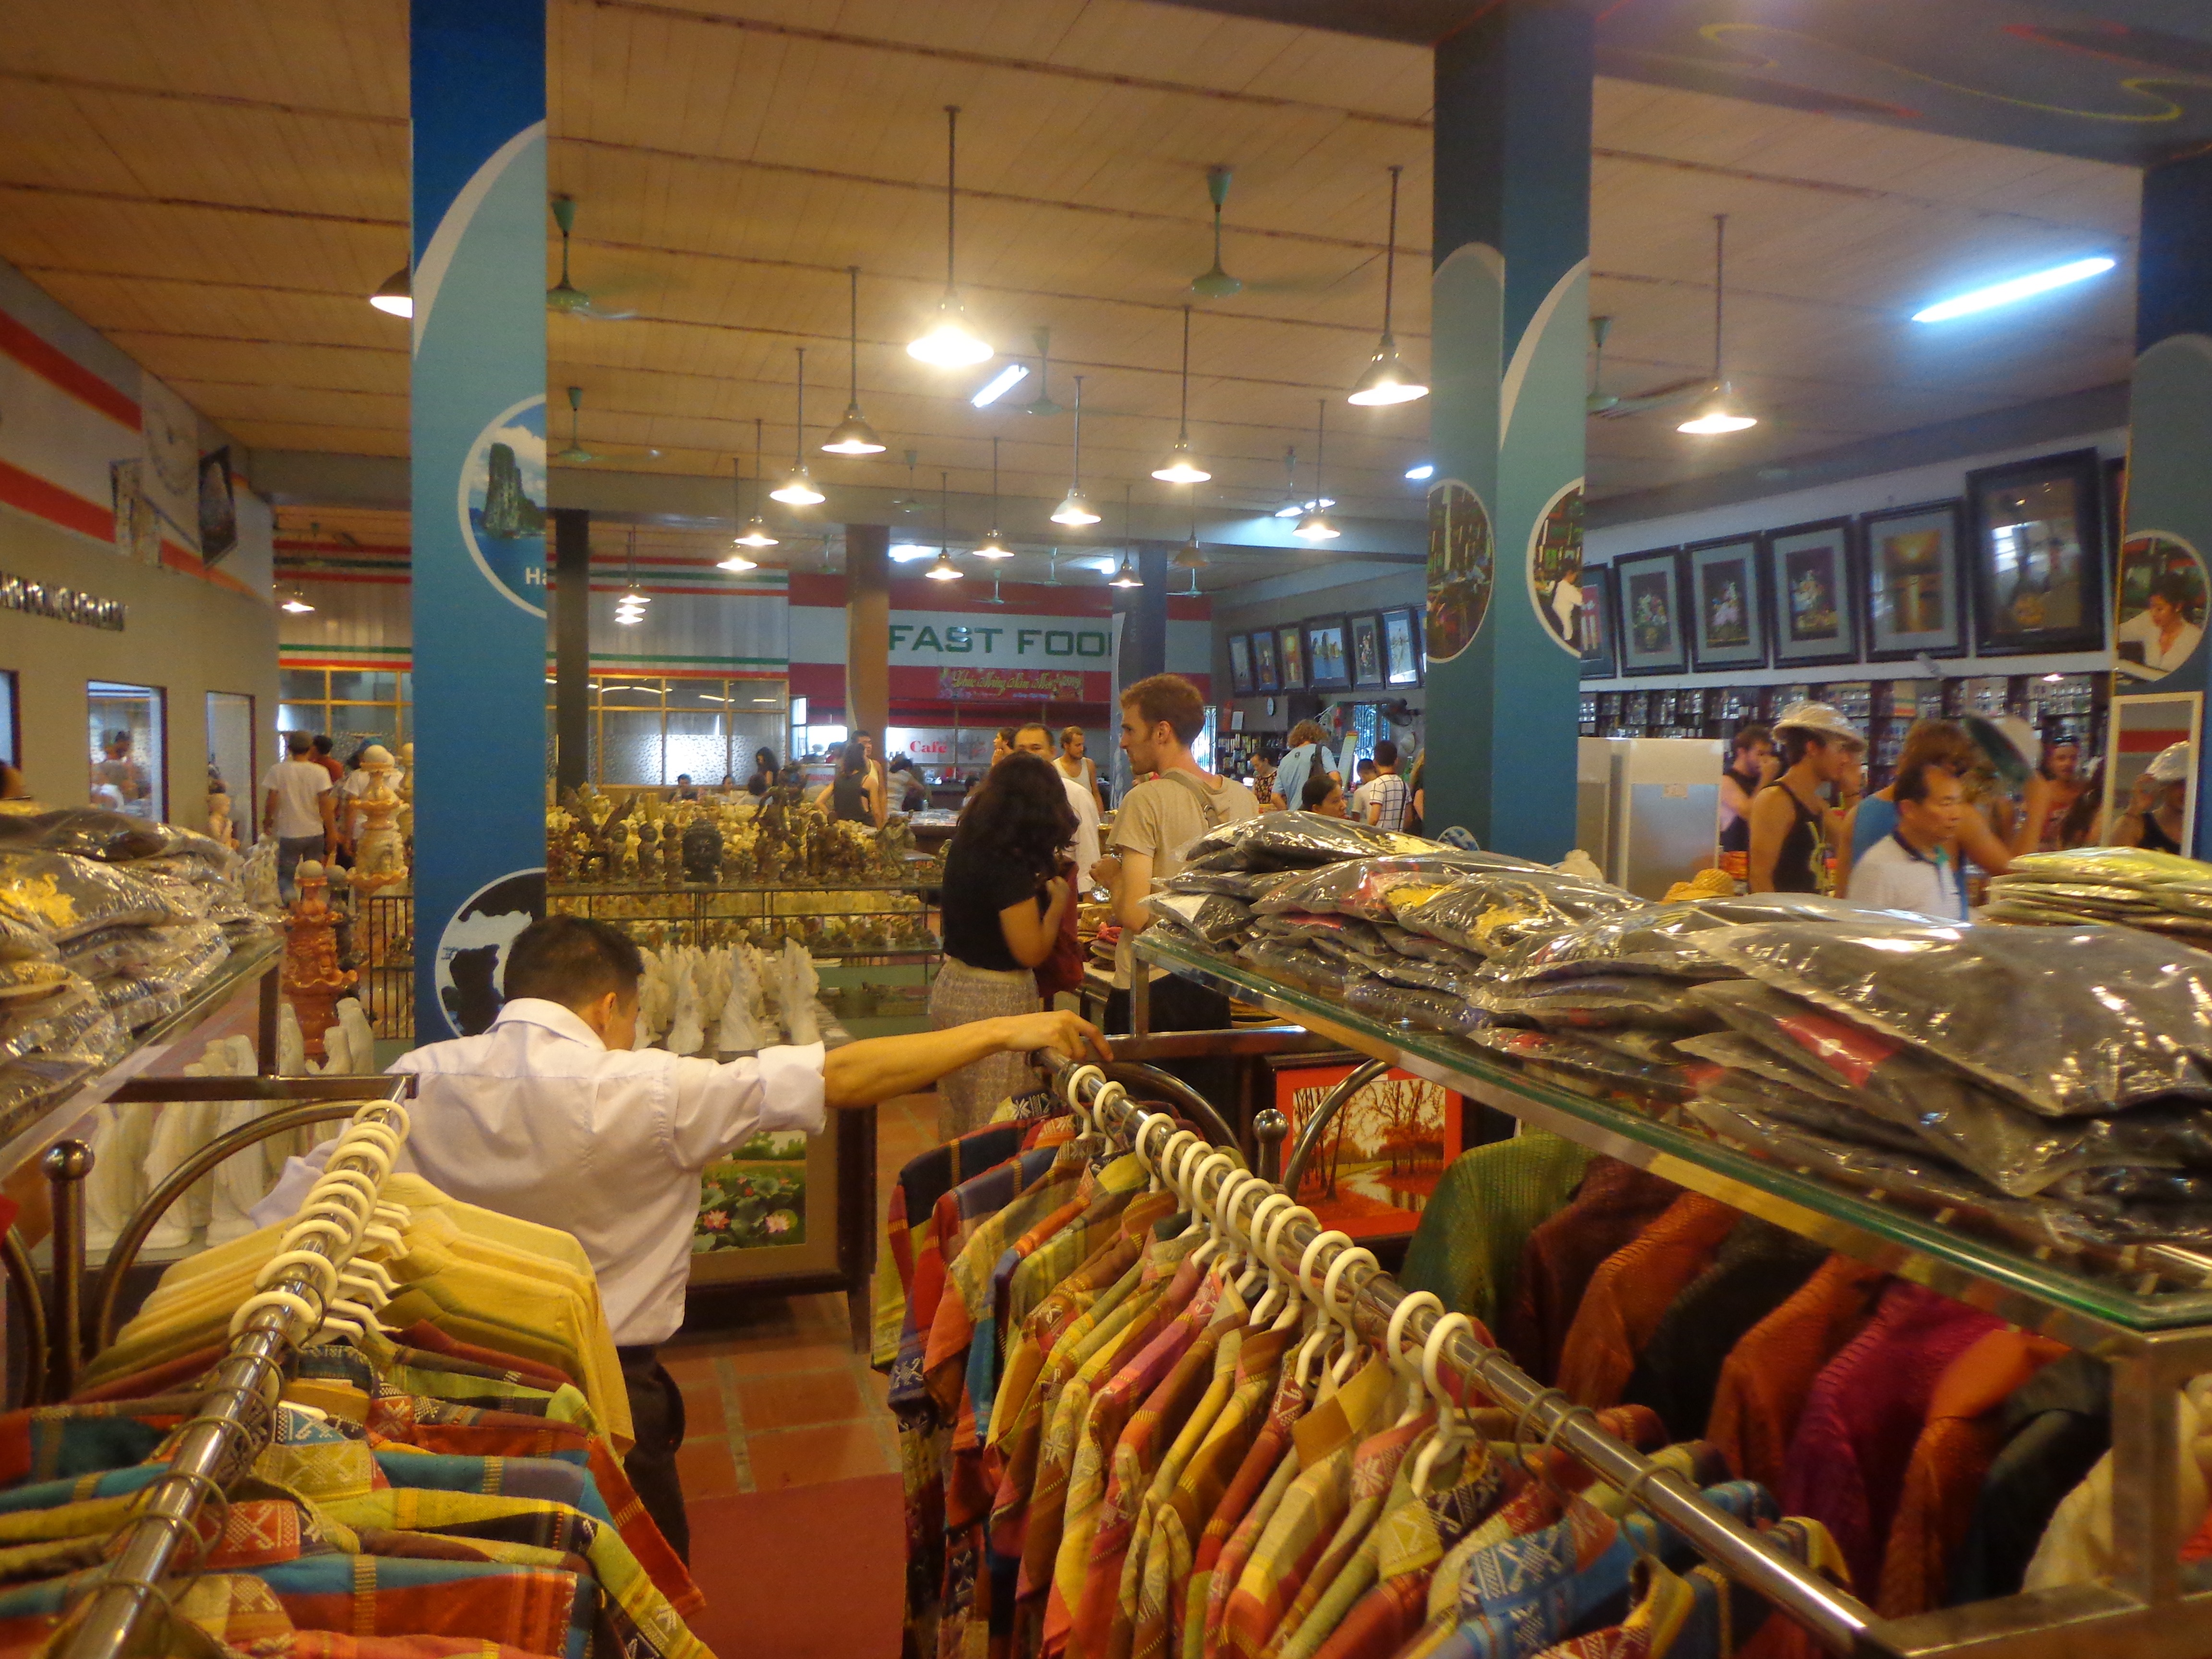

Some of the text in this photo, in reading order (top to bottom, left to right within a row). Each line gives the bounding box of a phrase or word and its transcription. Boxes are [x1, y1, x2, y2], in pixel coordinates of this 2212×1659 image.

[889, 625, 1112, 657] FAST FOO
[910, 740, 948, 753] Café
